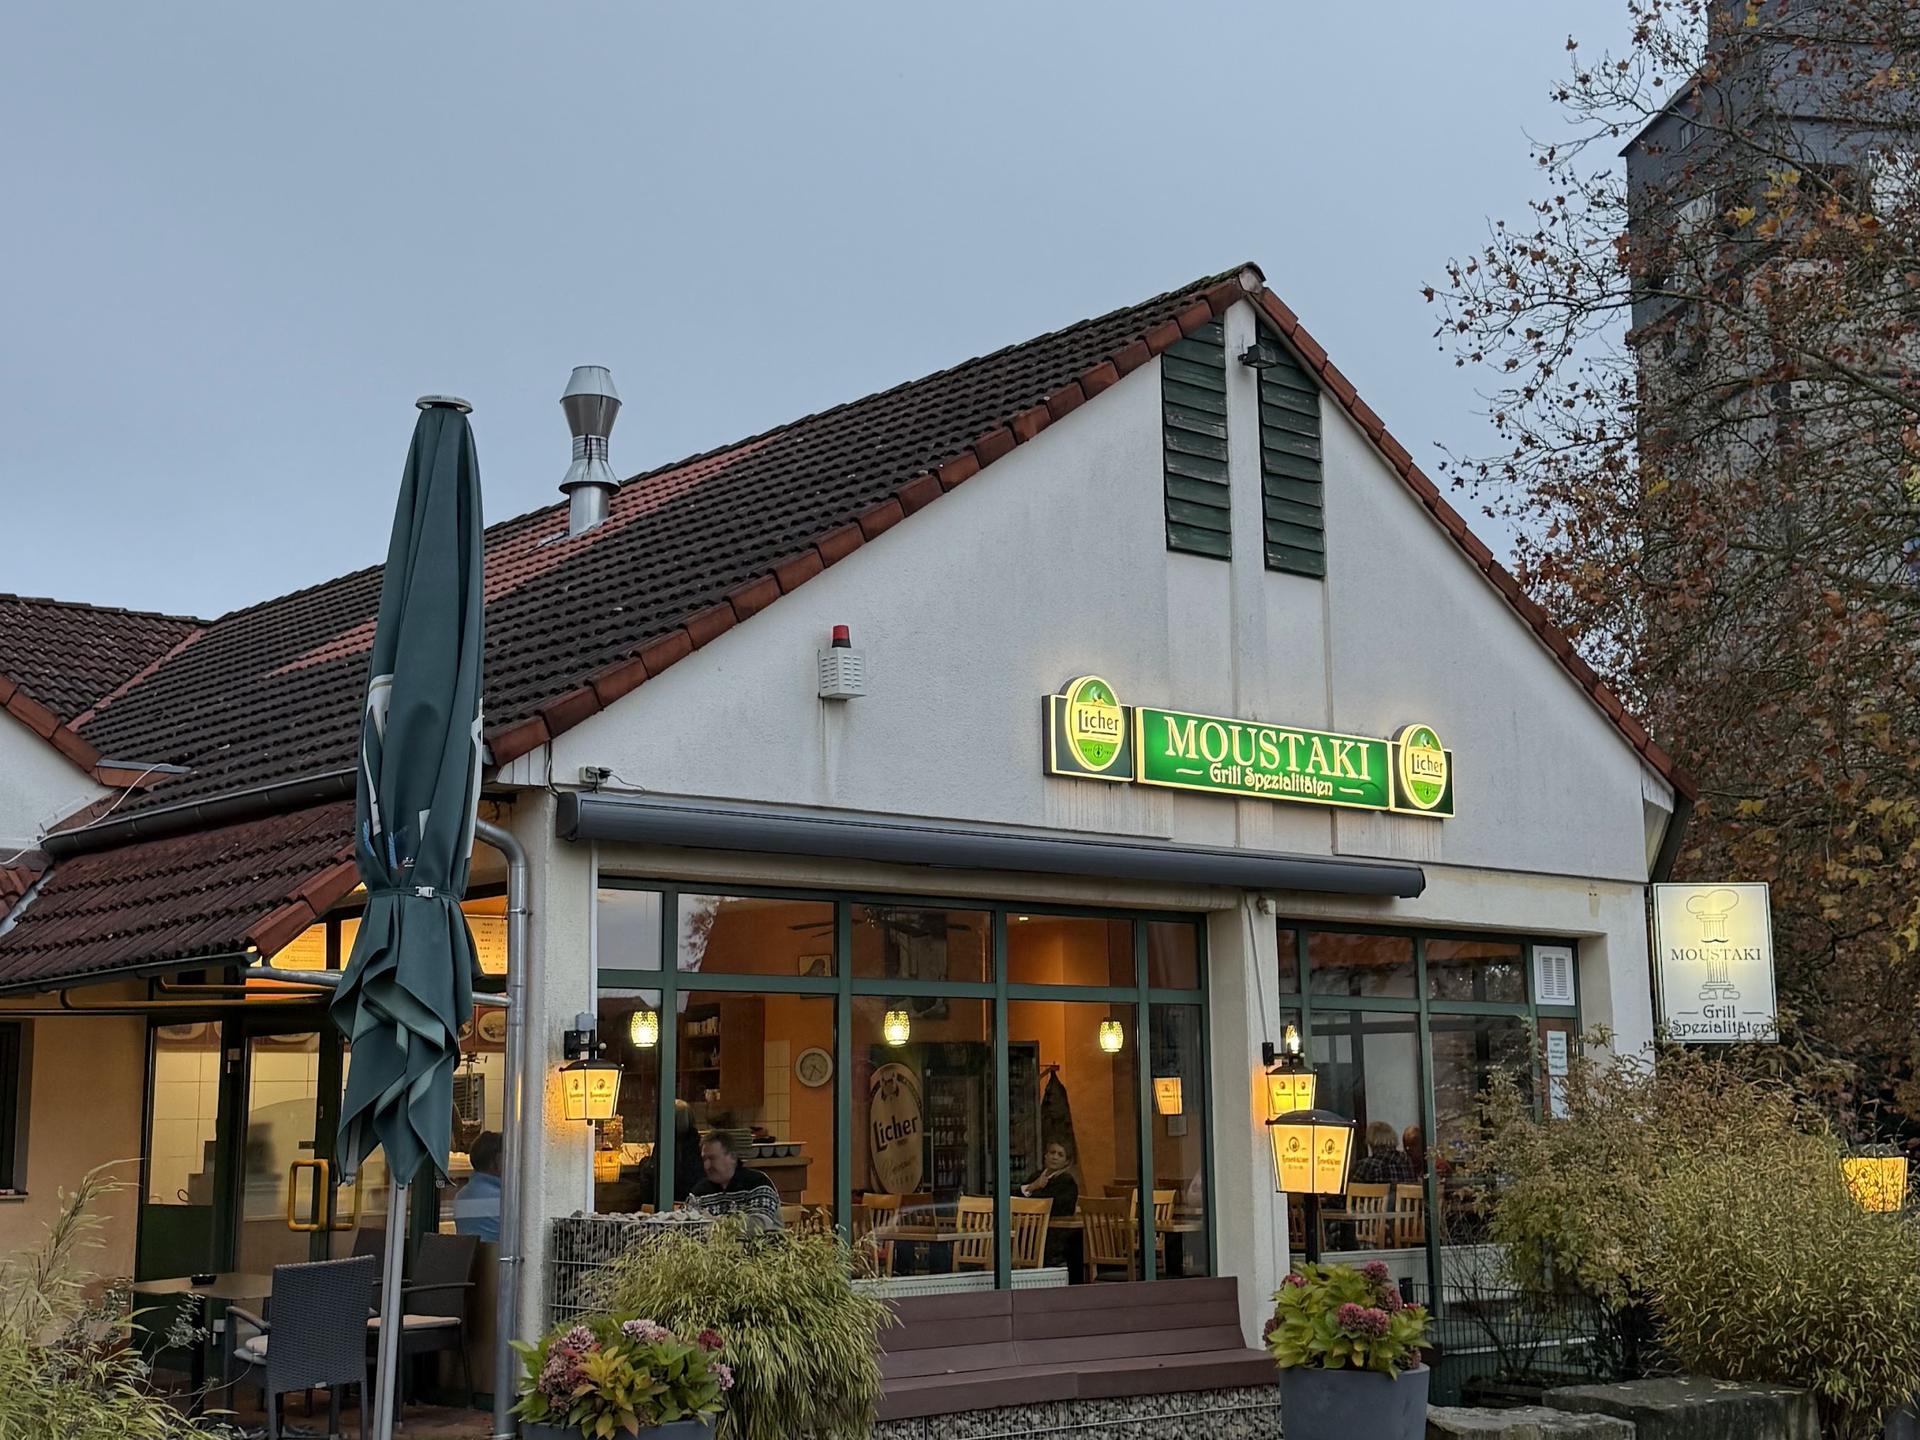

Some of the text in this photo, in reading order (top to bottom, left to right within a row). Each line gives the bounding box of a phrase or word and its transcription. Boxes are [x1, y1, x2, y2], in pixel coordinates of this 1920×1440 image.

[1078, 708, 1119, 733] Licher
[1163, 716, 1372, 781] MOUSTAKI
[1411, 753, 1443, 774] Licher
[1209, 762, 1333, 797] Grill Spezialitäten
[1671, 948, 1761, 961] MOUSTAKI
[1703, 1004, 1736, 1019] Grill
[873, 1115, 918, 1152] Licher
